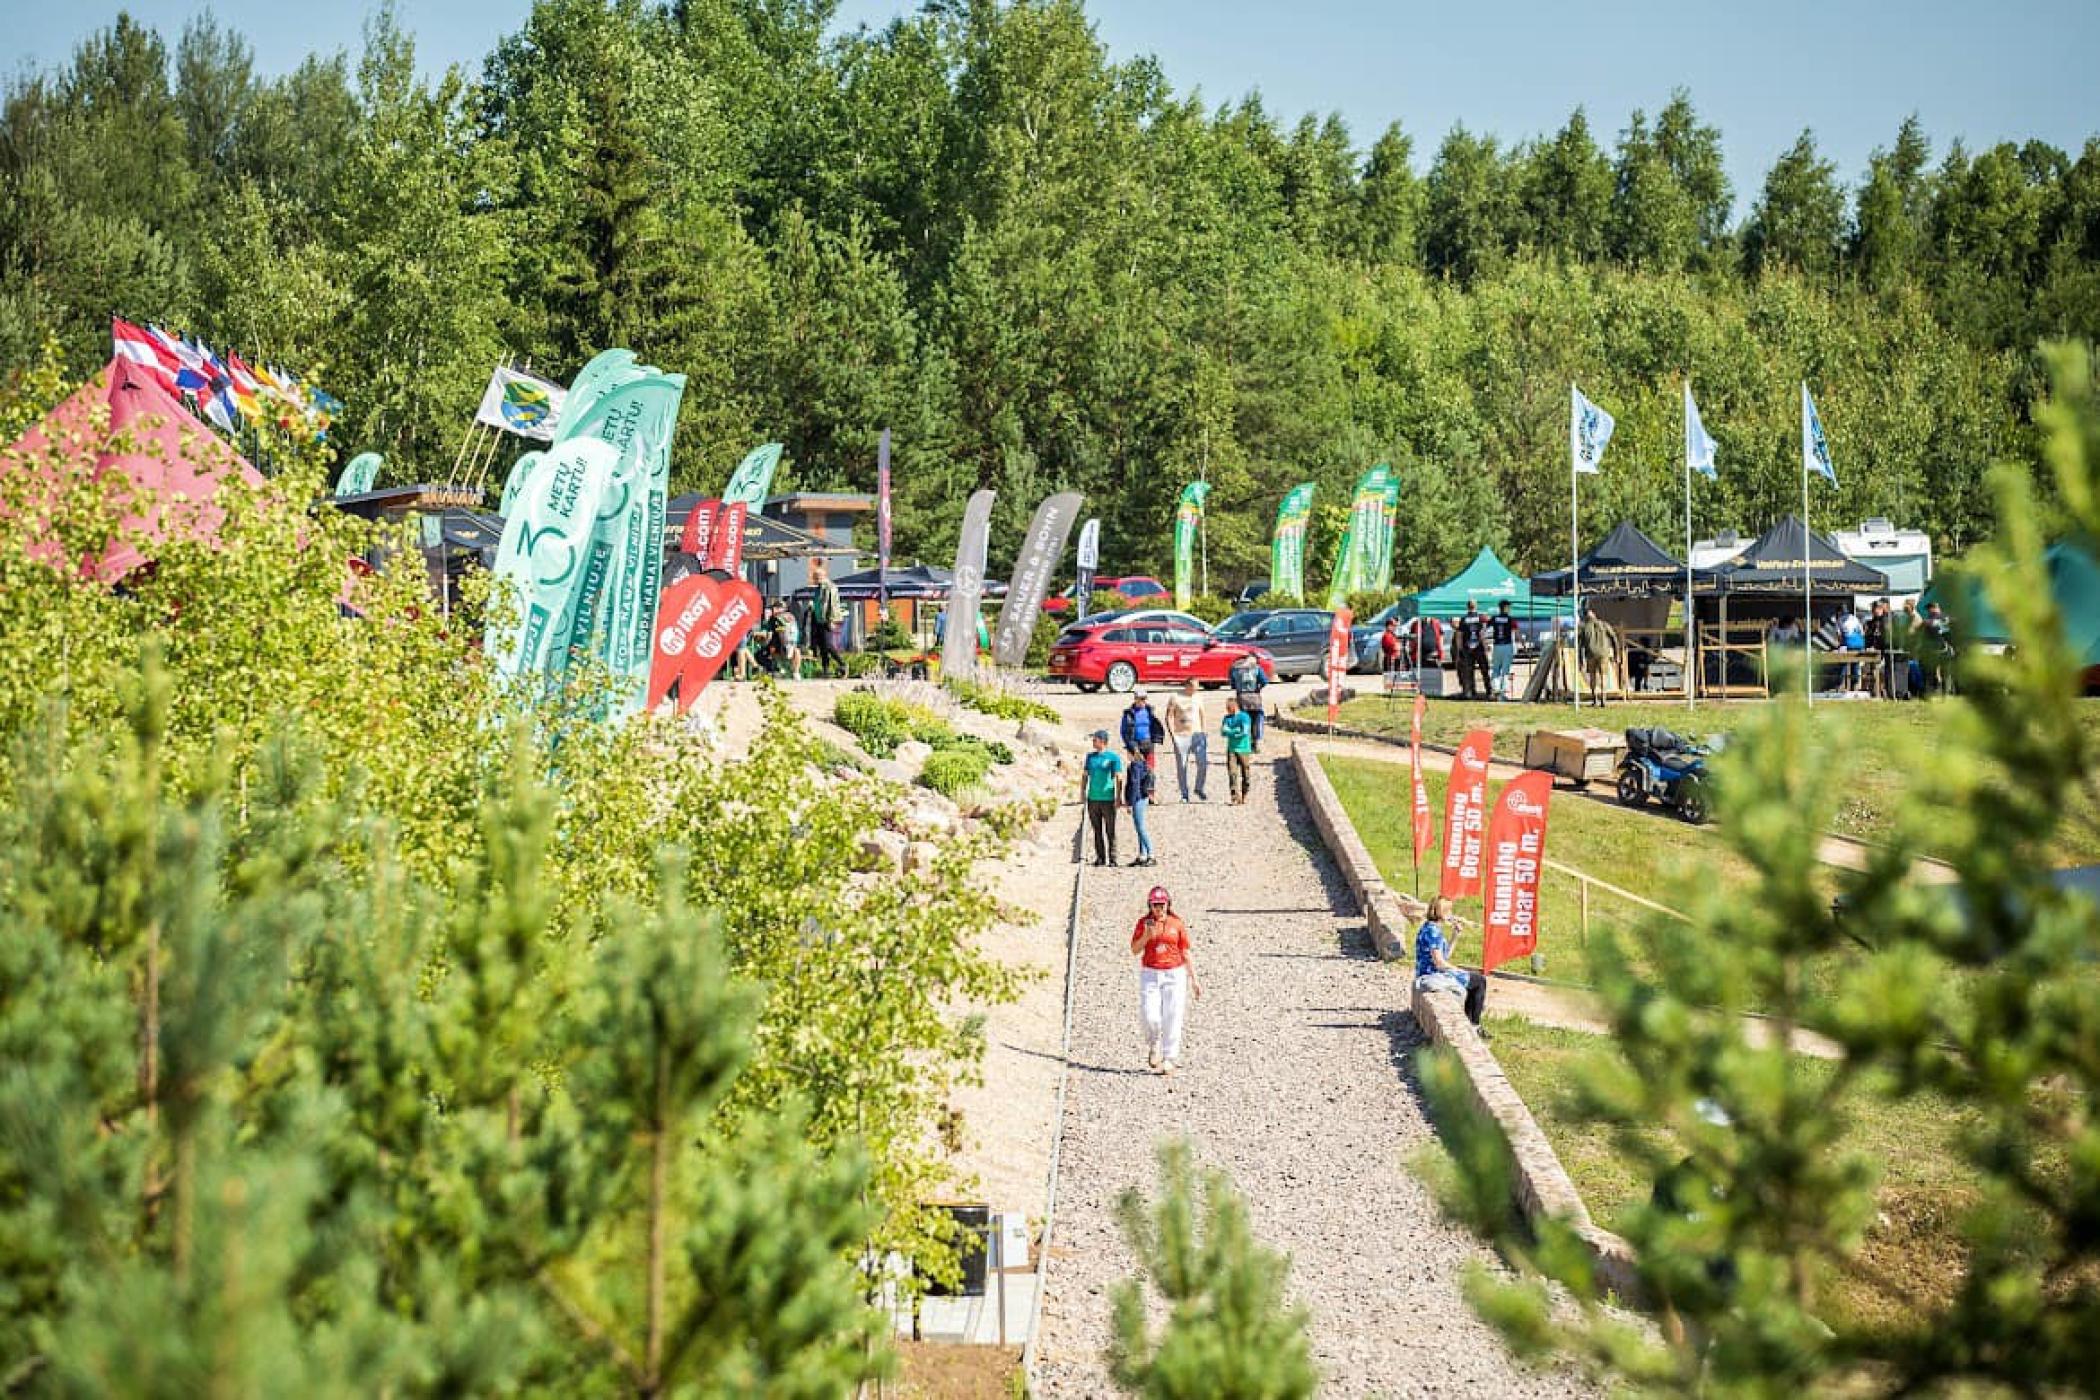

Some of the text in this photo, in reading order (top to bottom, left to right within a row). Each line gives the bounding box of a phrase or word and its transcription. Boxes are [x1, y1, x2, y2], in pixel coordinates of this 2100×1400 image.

[602, 408, 626, 441] ETŲ
[1446, 792, 1468, 868] Running
[1464, 808, 1482, 831] 50
[1459, 834, 1480, 878] Boar
[1514, 858, 1537, 884] 50
[1489, 842, 1518, 926] Running
[1510, 888, 1535, 936] Boar
